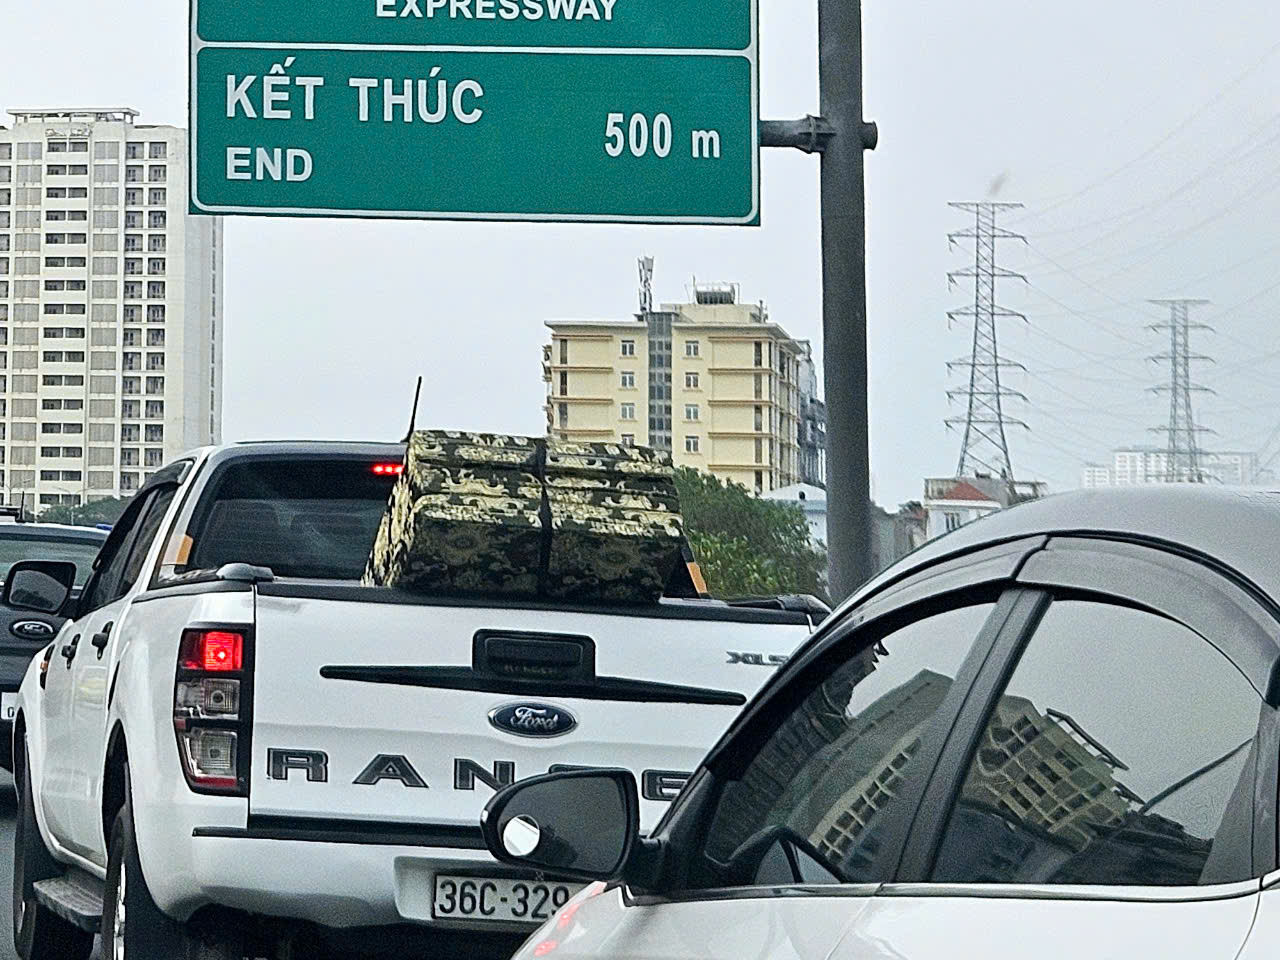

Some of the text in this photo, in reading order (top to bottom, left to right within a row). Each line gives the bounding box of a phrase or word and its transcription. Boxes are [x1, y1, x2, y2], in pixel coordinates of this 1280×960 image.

[225, 56, 485, 124] KẾT THÚC
[604, 112, 721, 159] 500 m
[225, 147, 314, 182] END
[510, 706, 559, 730] Ford
[267, 747, 694, 802] RANE
